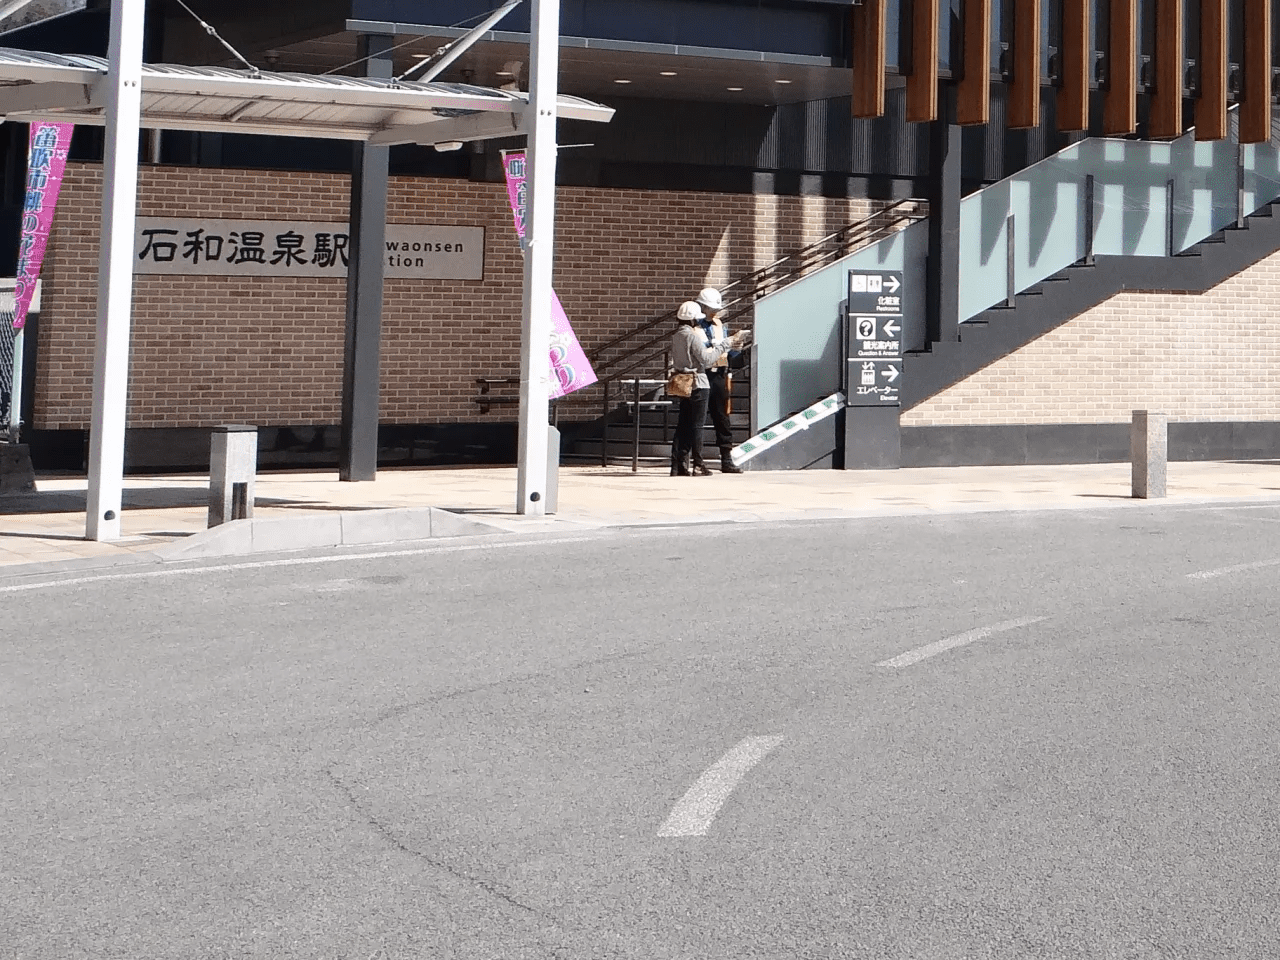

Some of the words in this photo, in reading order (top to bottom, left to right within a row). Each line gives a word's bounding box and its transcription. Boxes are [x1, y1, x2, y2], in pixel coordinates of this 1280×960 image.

[138, 228, 349, 268] 石和温泉駅
[385, 241, 464, 253] waonsen
[388, 254, 424, 267] tion
[856, 386, 899, 395] エレベーター
